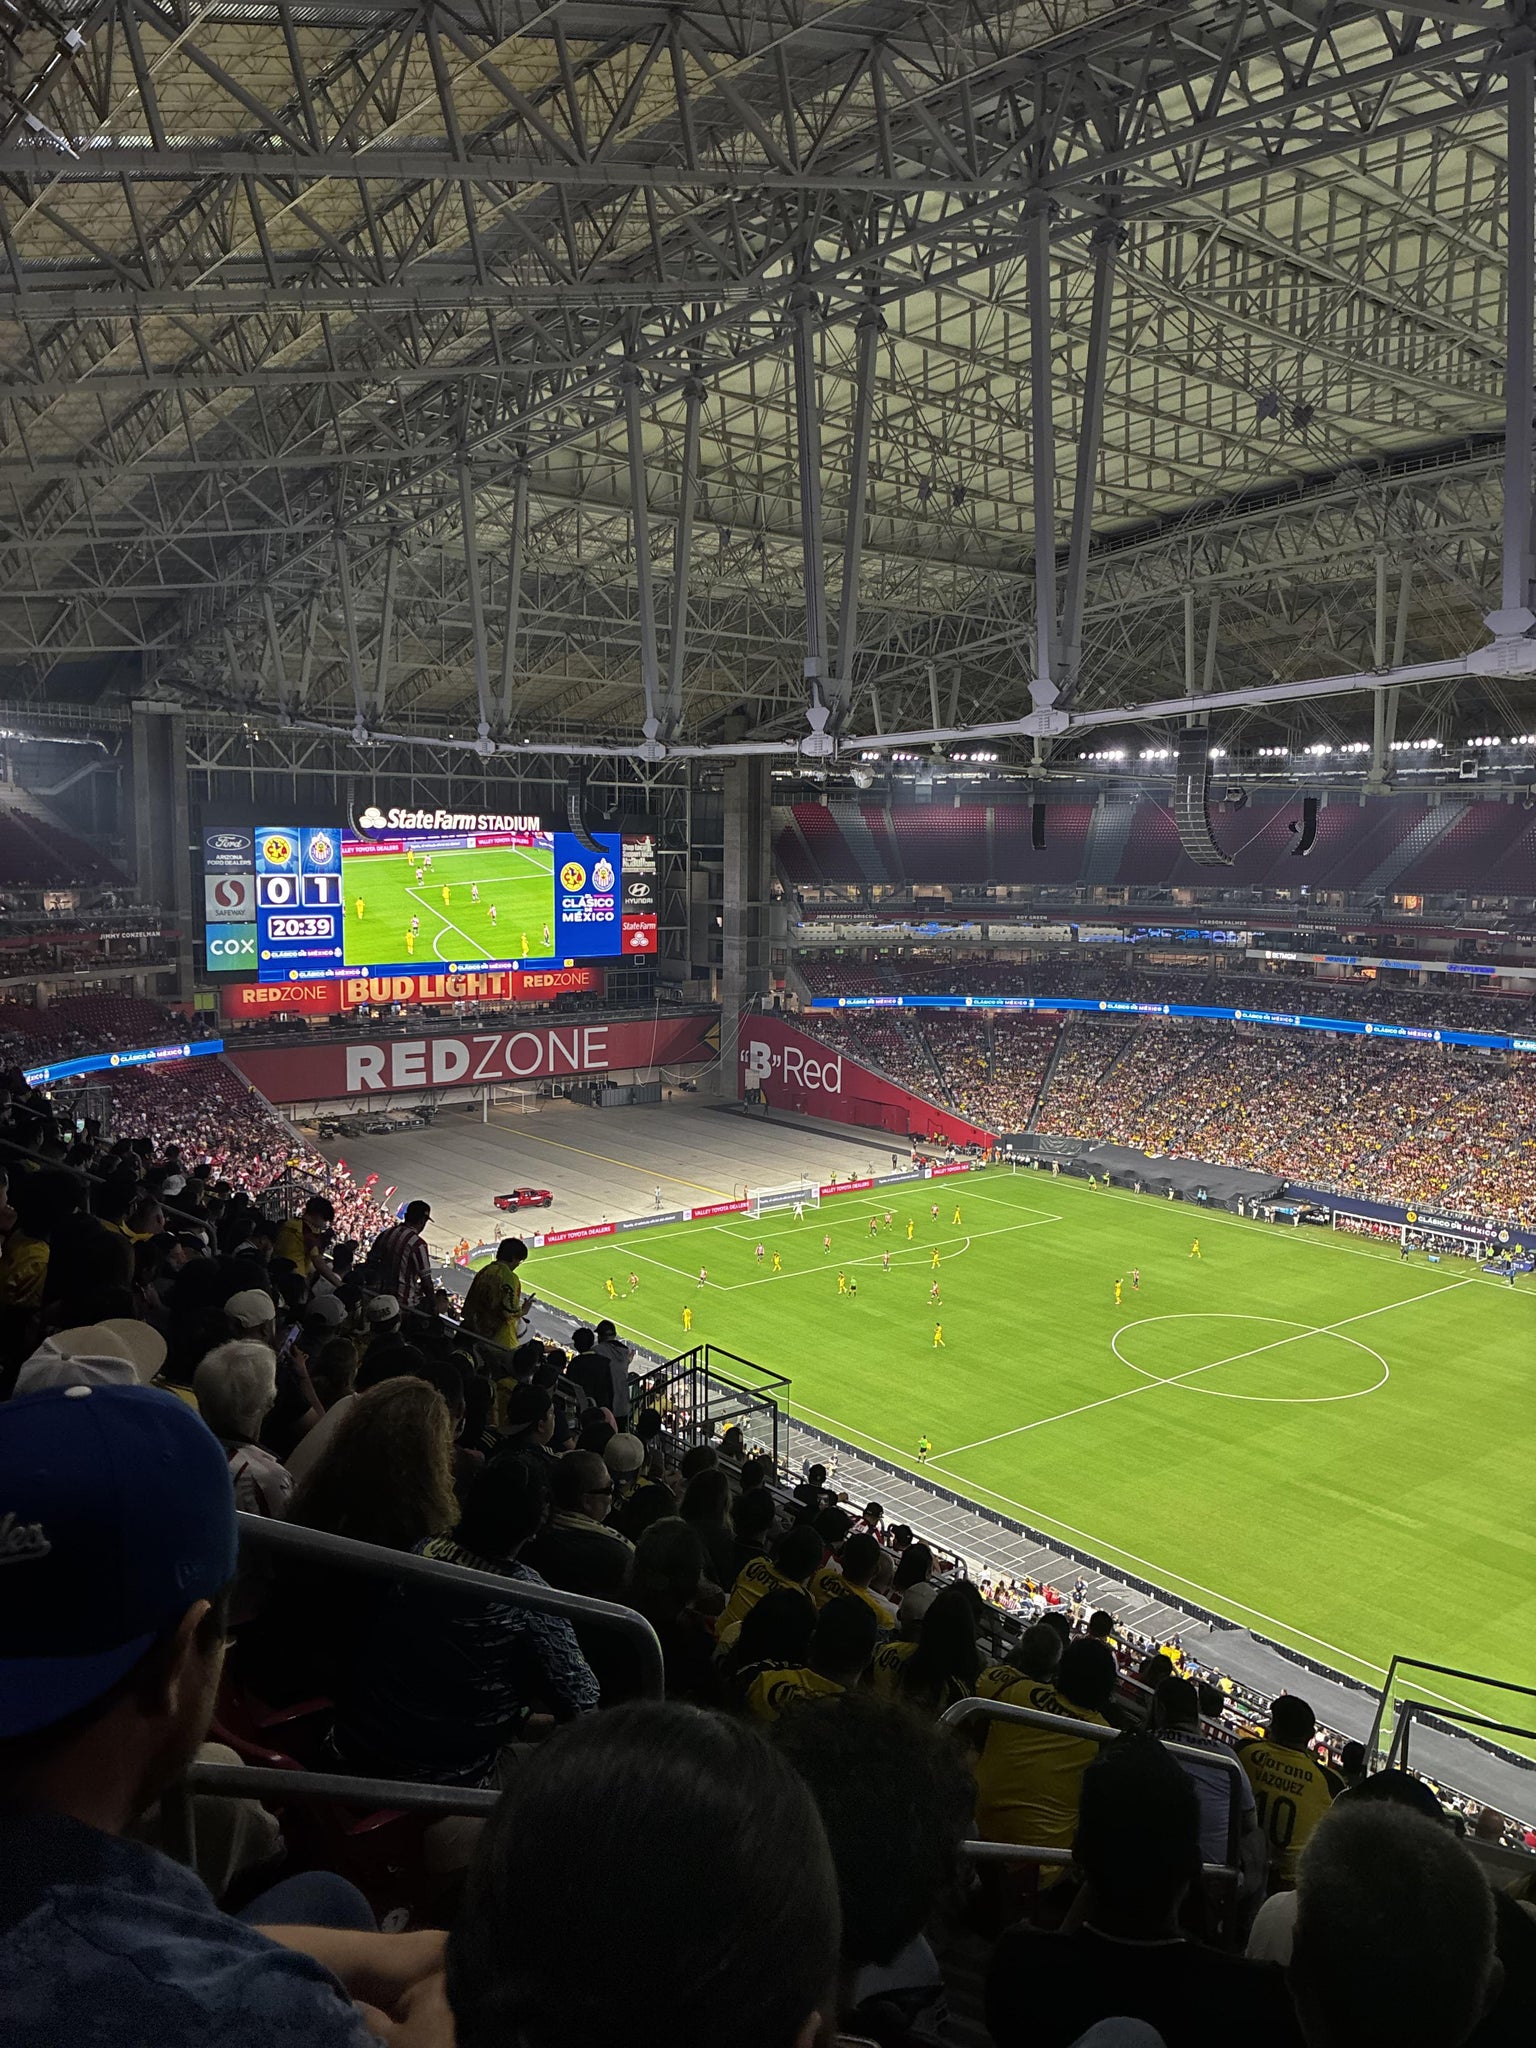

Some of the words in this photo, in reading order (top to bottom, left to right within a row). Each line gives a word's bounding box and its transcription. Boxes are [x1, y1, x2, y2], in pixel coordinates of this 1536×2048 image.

[478, 815, 541, 831] STADIUM
[215, 834, 243, 849] Ford
[376, 844, 399, 852] DEALERS
[267, 876, 291, 904] 0
[313, 877, 328, 903] 1
[562, 896, 614, 908] CLÁSICO
[215, 909, 246, 917] SAFEWAY
[562, 910, 615, 922] MÉXICO
[273, 919, 331, 937] 20:39
[210, 938, 255, 956] COX
[348, 976, 415, 1002] BUD
[419, 972, 506, 1000] LIGHT
[523, 972, 590, 988] REDZONE
[243, 985, 327, 1004] REDZONE
[345, 1026, 609, 1092] REDZONE
[783, 1046, 842, 1094] Red
[933, 1167, 949, 1175] VALLEY
[821, 1186, 836, 1194] VALLEY
[836, 1183, 852, 1191] TOYOTA
[852, 1180, 869, 1189] DEALERS
[694, 1208, 711, 1217] VALLEY
[711, 1204, 729, 1213] TOYOTA
[729, 1200, 750, 1210] DEALERS
[547, 1233, 567, 1243] VALLEY
[567, 1230, 588, 1239] TOYOTA
[588, 1225, 611, 1236] DEALERS
[1417, 1215, 1450, 1228] CLÁSICO
[1450, 1220, 1462, 1230] DE
[1463, 1223, 1498, 1238] MÉXICO
[1251, 1750, 1313, 1783] Corona
[1255, 1770, 1305, 1796] VAZQUEZ
[1254, 1790, 1297, 1849] 10
